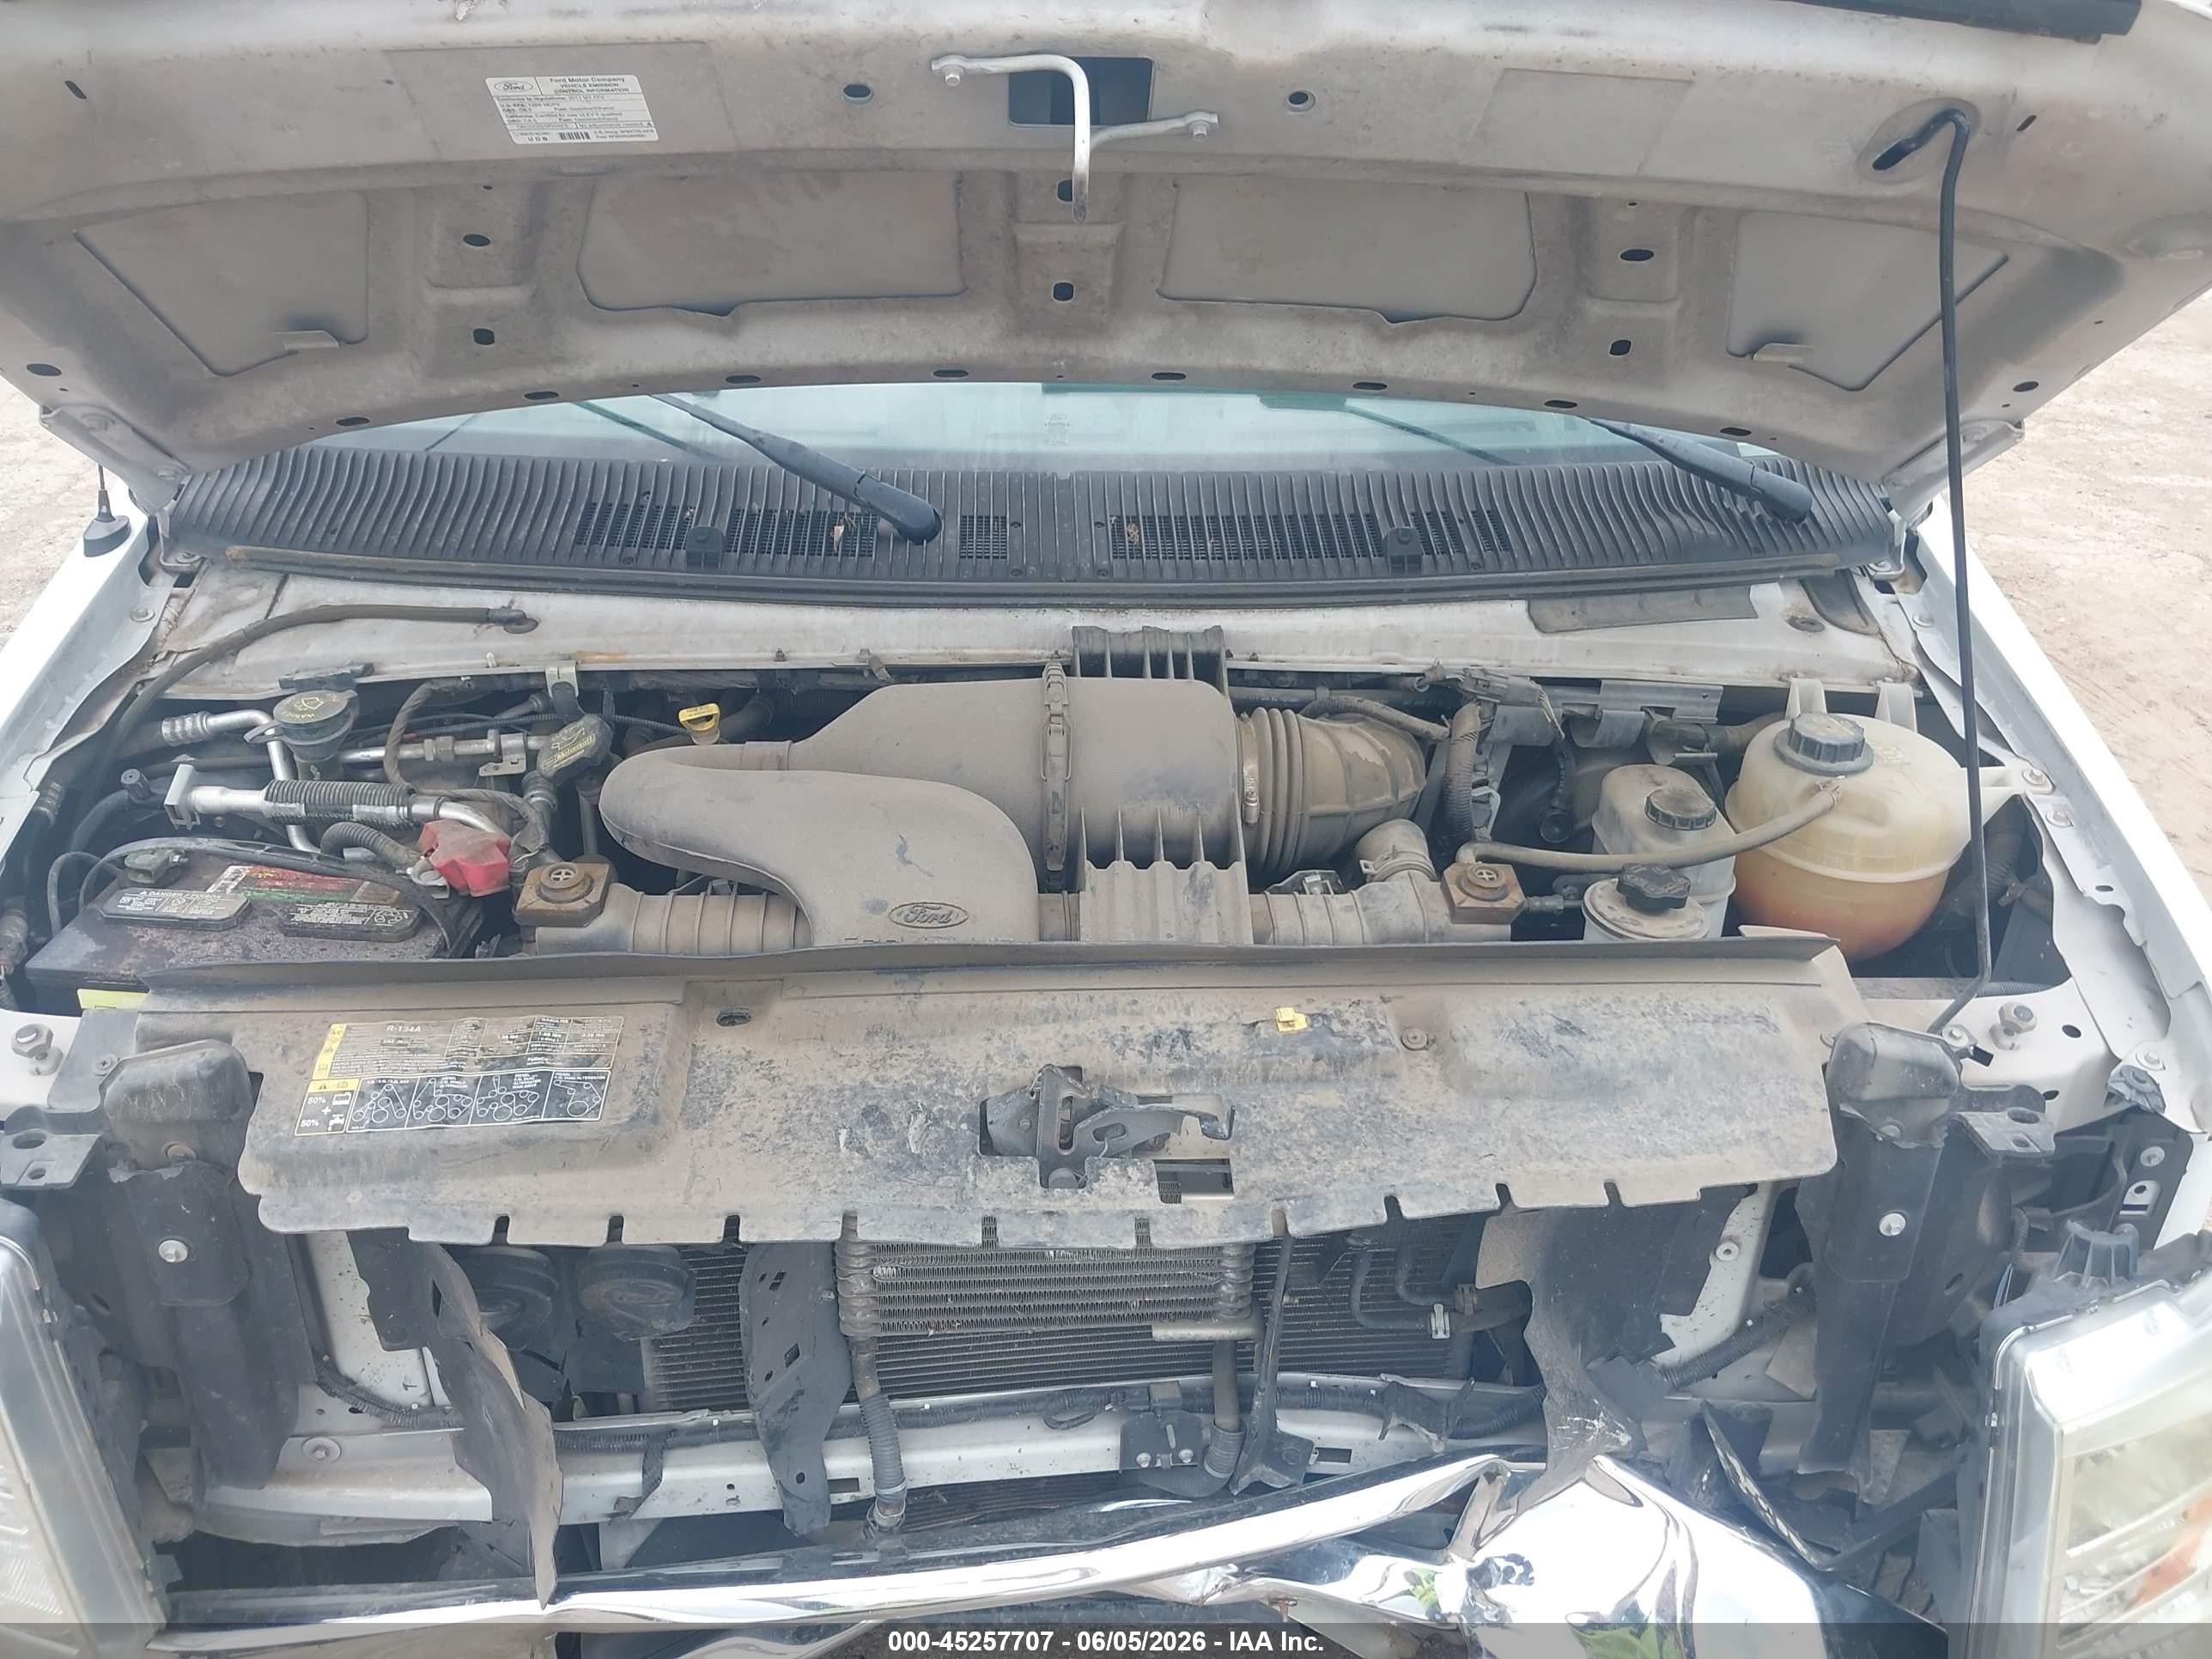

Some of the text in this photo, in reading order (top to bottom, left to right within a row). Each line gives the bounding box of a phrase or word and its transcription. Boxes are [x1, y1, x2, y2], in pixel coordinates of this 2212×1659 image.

[502, 81, 525, 91] Ford
[904, 905, 953, 924] Ford
[386, 1024, 422, 1033] R-134A
[307, 1096, 326, 1105] 50%
[300, 1118, 319, 1127] 50%
